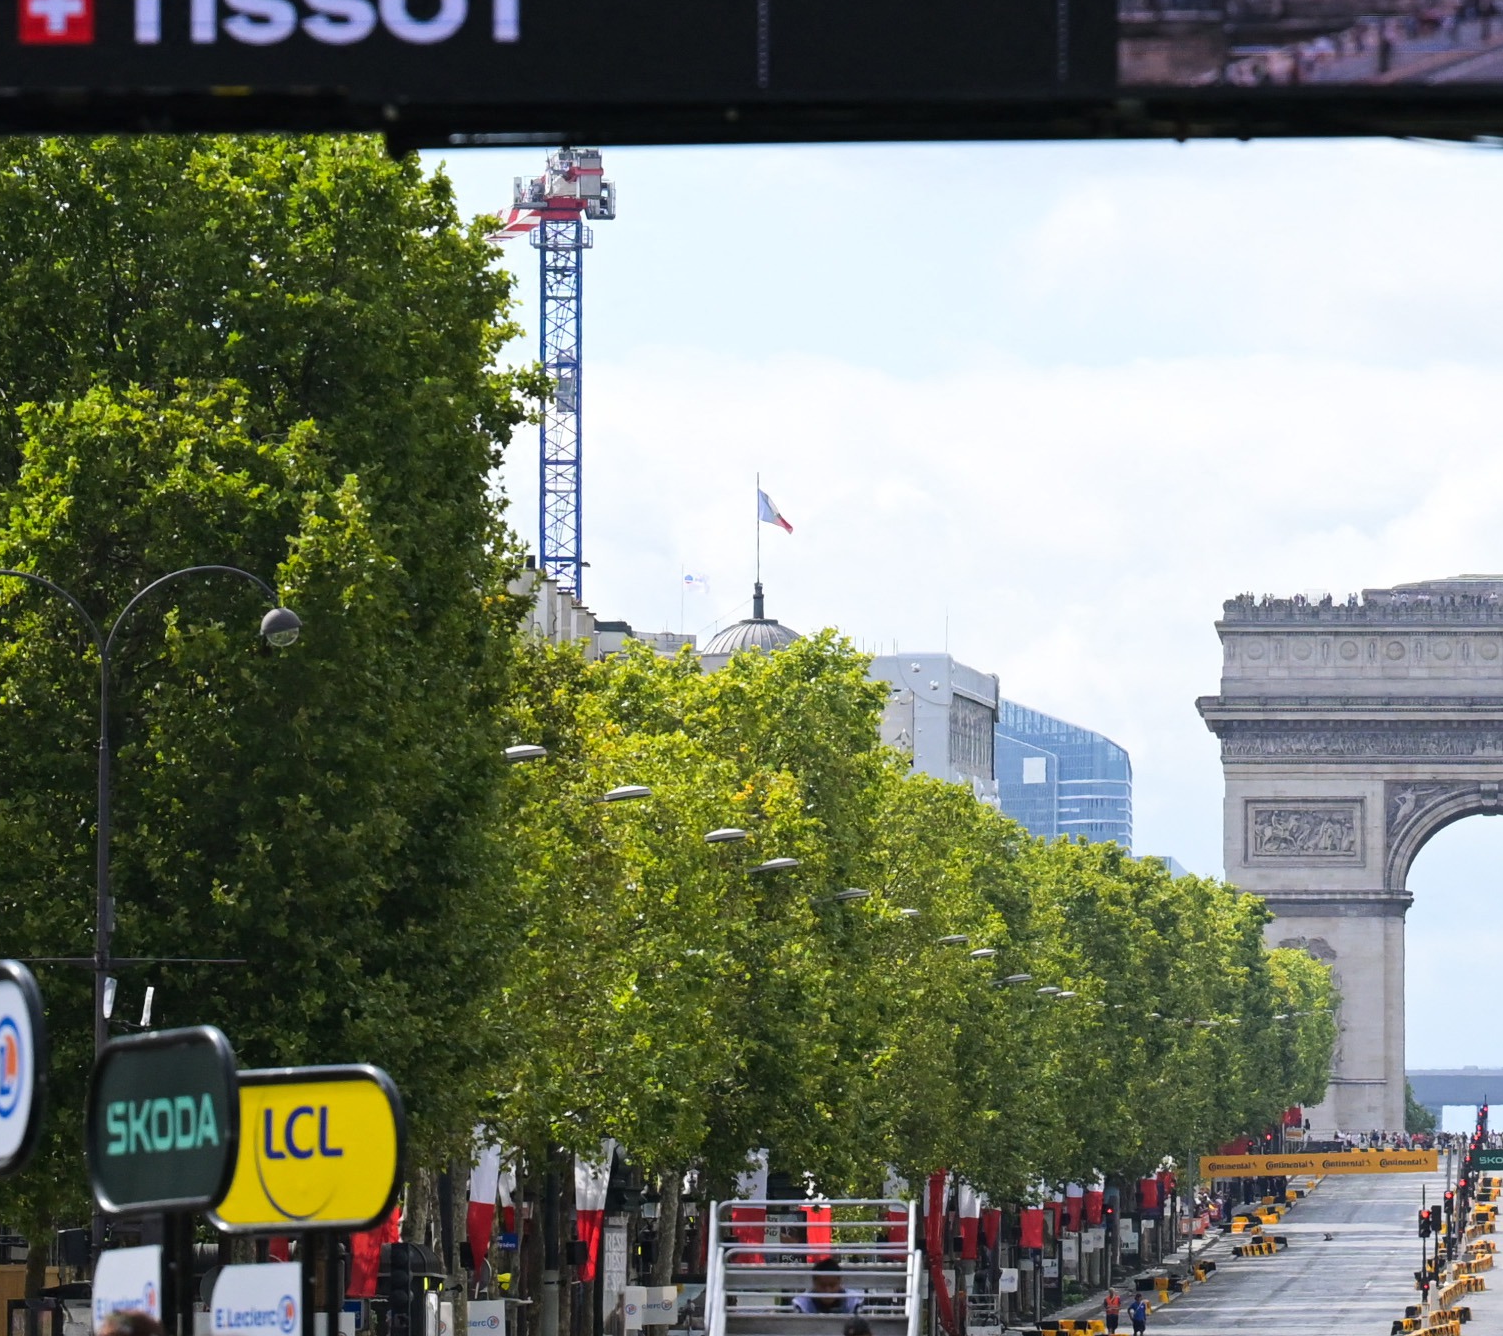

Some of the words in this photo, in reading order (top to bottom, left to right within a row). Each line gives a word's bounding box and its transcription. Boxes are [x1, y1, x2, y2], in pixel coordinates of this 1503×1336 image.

[106, 1092, 220, 1157] SKODA
[263, 1105, 344, 1161] LCL
[1208, 1162, 1252, 1172] Continental
[1265, 1160, 1308, 1171] Continental
[1322, 1159, 1365, 1170] Continental
[1379, 1158, 1422, 1169] Continental
[215, 1306, 279, 1328] E.Leclerc
